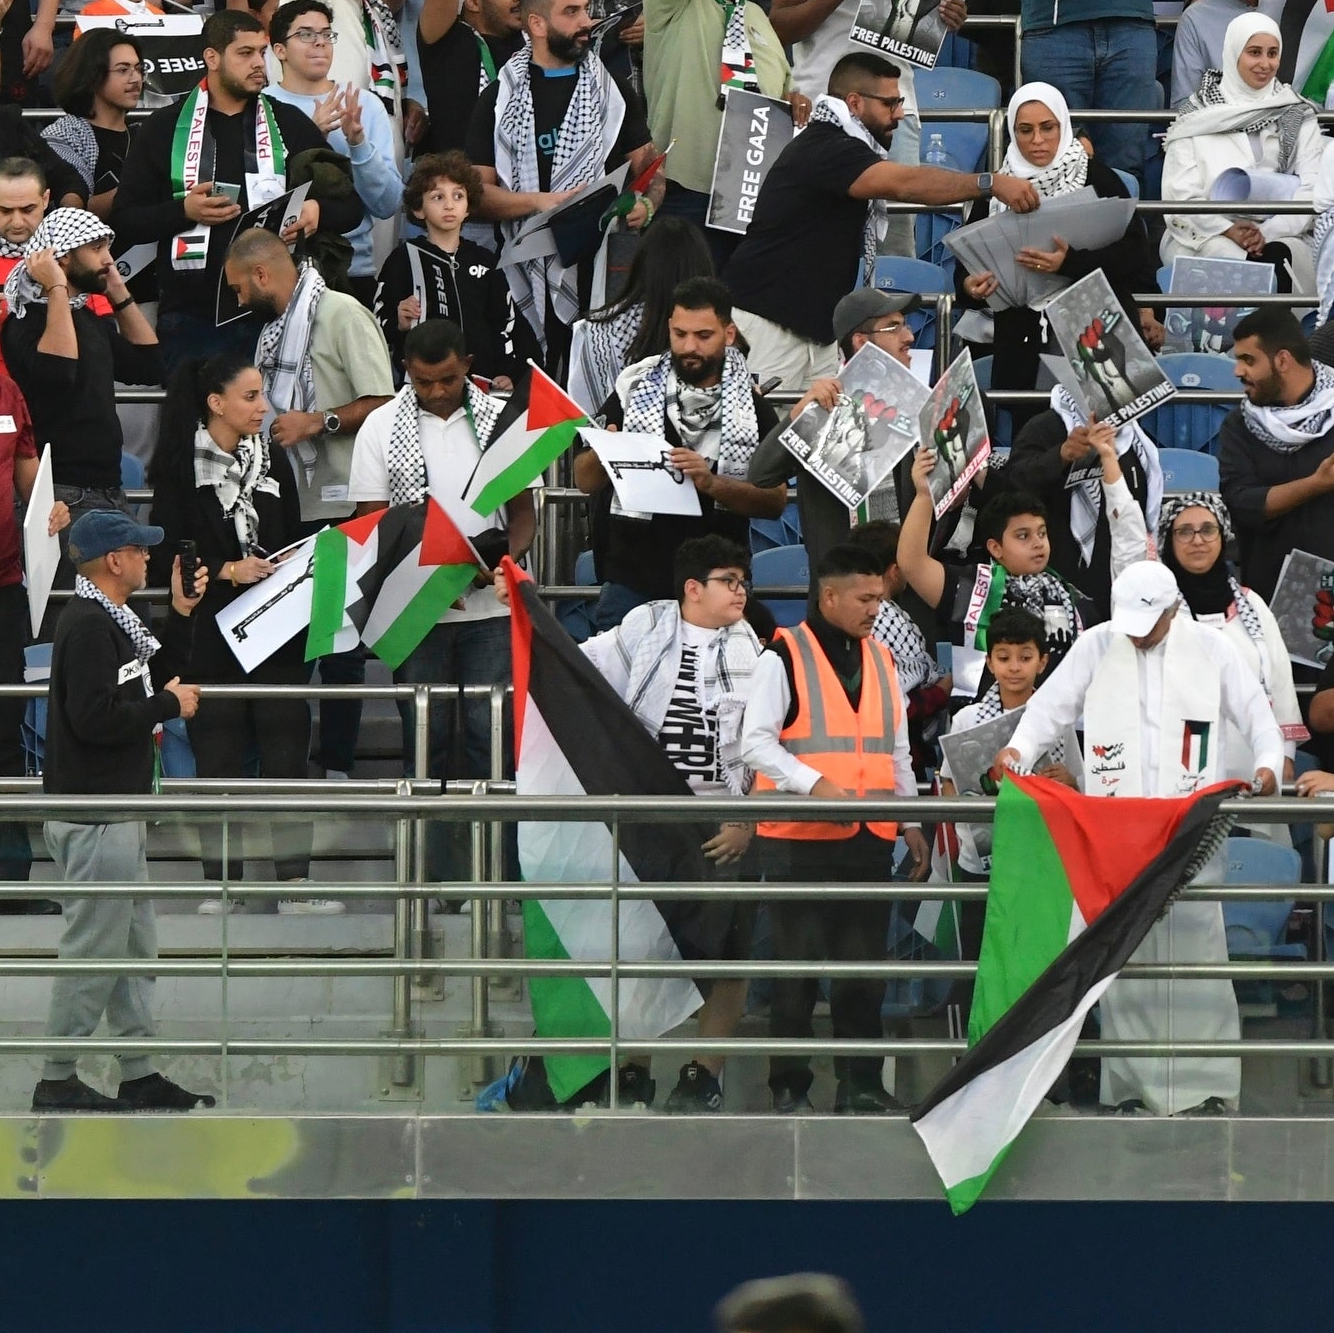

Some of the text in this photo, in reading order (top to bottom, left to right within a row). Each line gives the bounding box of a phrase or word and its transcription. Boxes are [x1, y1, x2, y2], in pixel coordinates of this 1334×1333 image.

[852, 25, 935, 67] FREE PALESTINE
[933, 90, 947, 98] 33
[183, 105, 206, 195] PALESTIN
[737, 106, 771, 223] FREE GAZA
[432, 264, 450, 317] FREE
[880, 279, 893, 287] 33
[1118, 381, 1173, 419] PALESTINE
[782, 428, 863, 507] FREE PALESTINE
[936, 446, 991, 516] FREE PALESTINE
[966, 565, 991, 632] PALESTI
[1091, 762, 1126, 775] فلسطين
[1101, 776, 1120, 787] حرة
